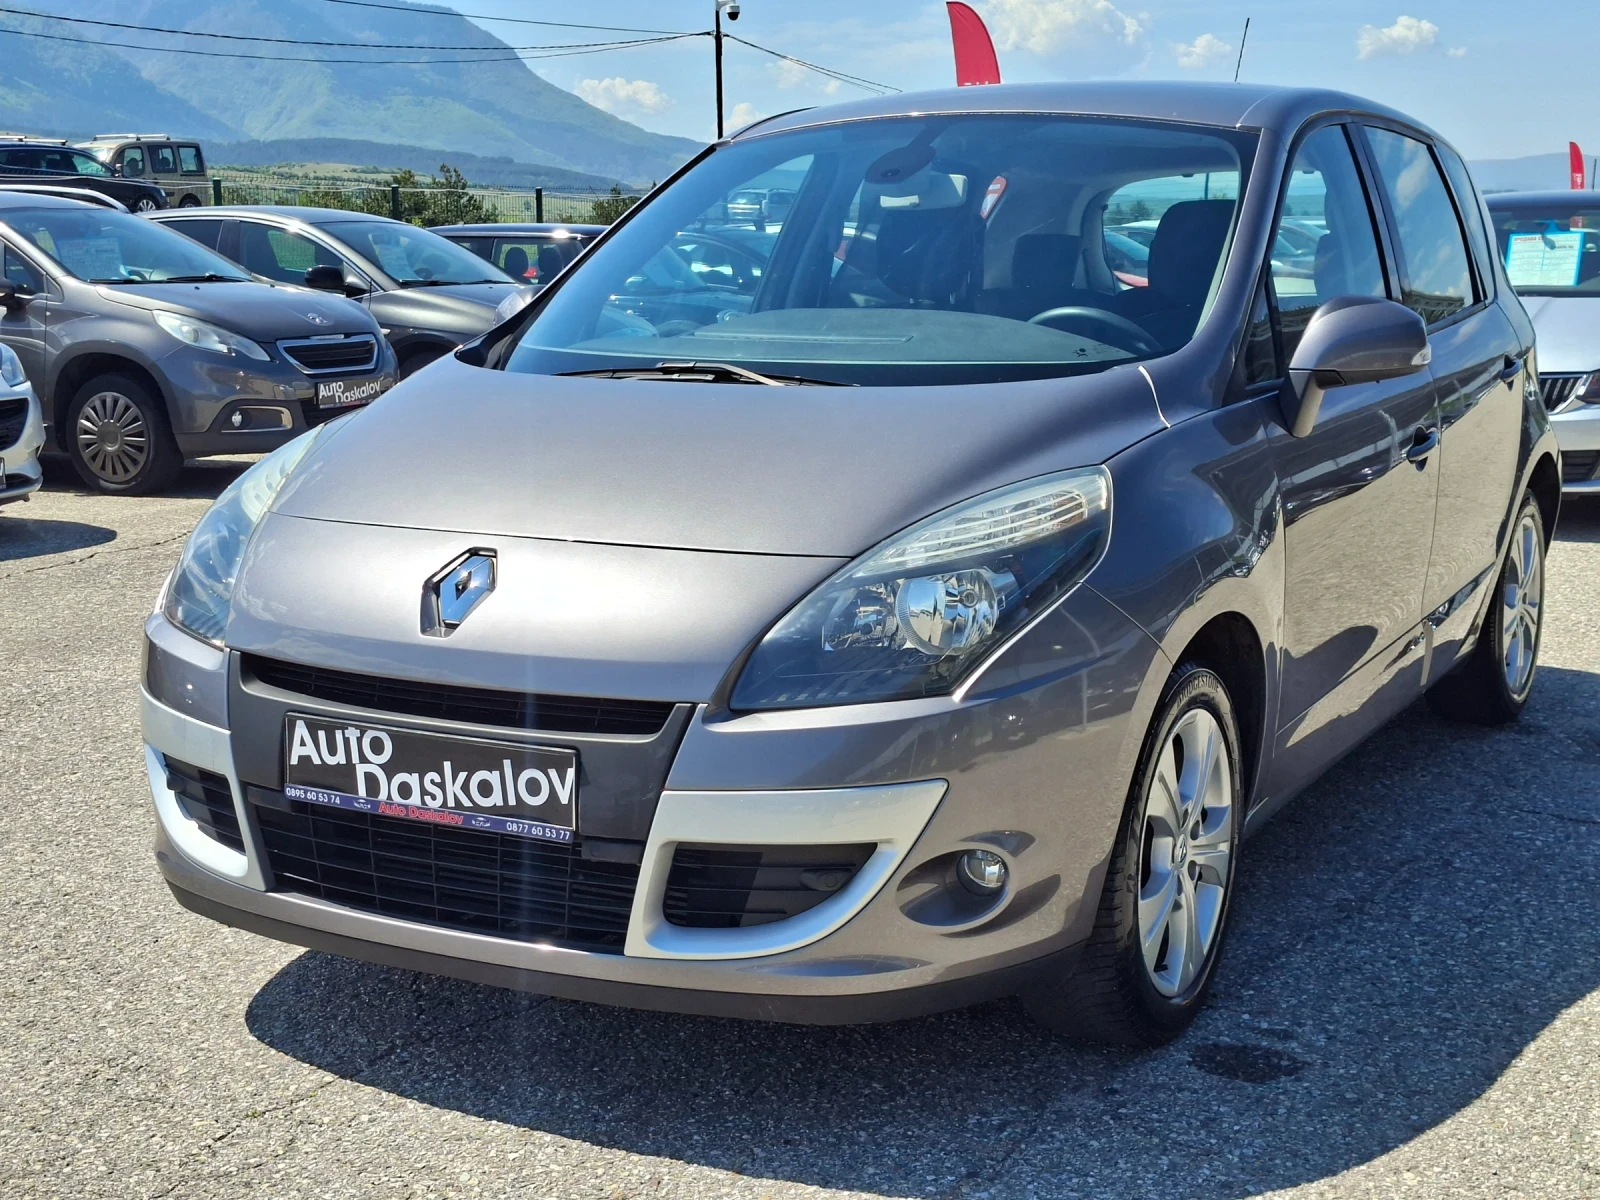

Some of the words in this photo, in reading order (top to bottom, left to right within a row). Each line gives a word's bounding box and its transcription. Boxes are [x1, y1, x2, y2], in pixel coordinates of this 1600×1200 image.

[320, 381, 344, 399] Auto
[290, 719, 393, 766] Auto
[355, 759, 575, 808] Daskalov
[285, 787, 305, 799] 0895
[306, 791, 317, 801] 60
[318, 793, 329, 803] 53
[330, 795, 341, 805] 74
[379, 801, 407, 816] Auto
[408, 806, 464, 825] Daskalov
[506, 821, 528, 834] 0877
[531, 826, 543, 836] 60
[545, 828, 557, 839] 53
[559, 830, 570, 841] 77
